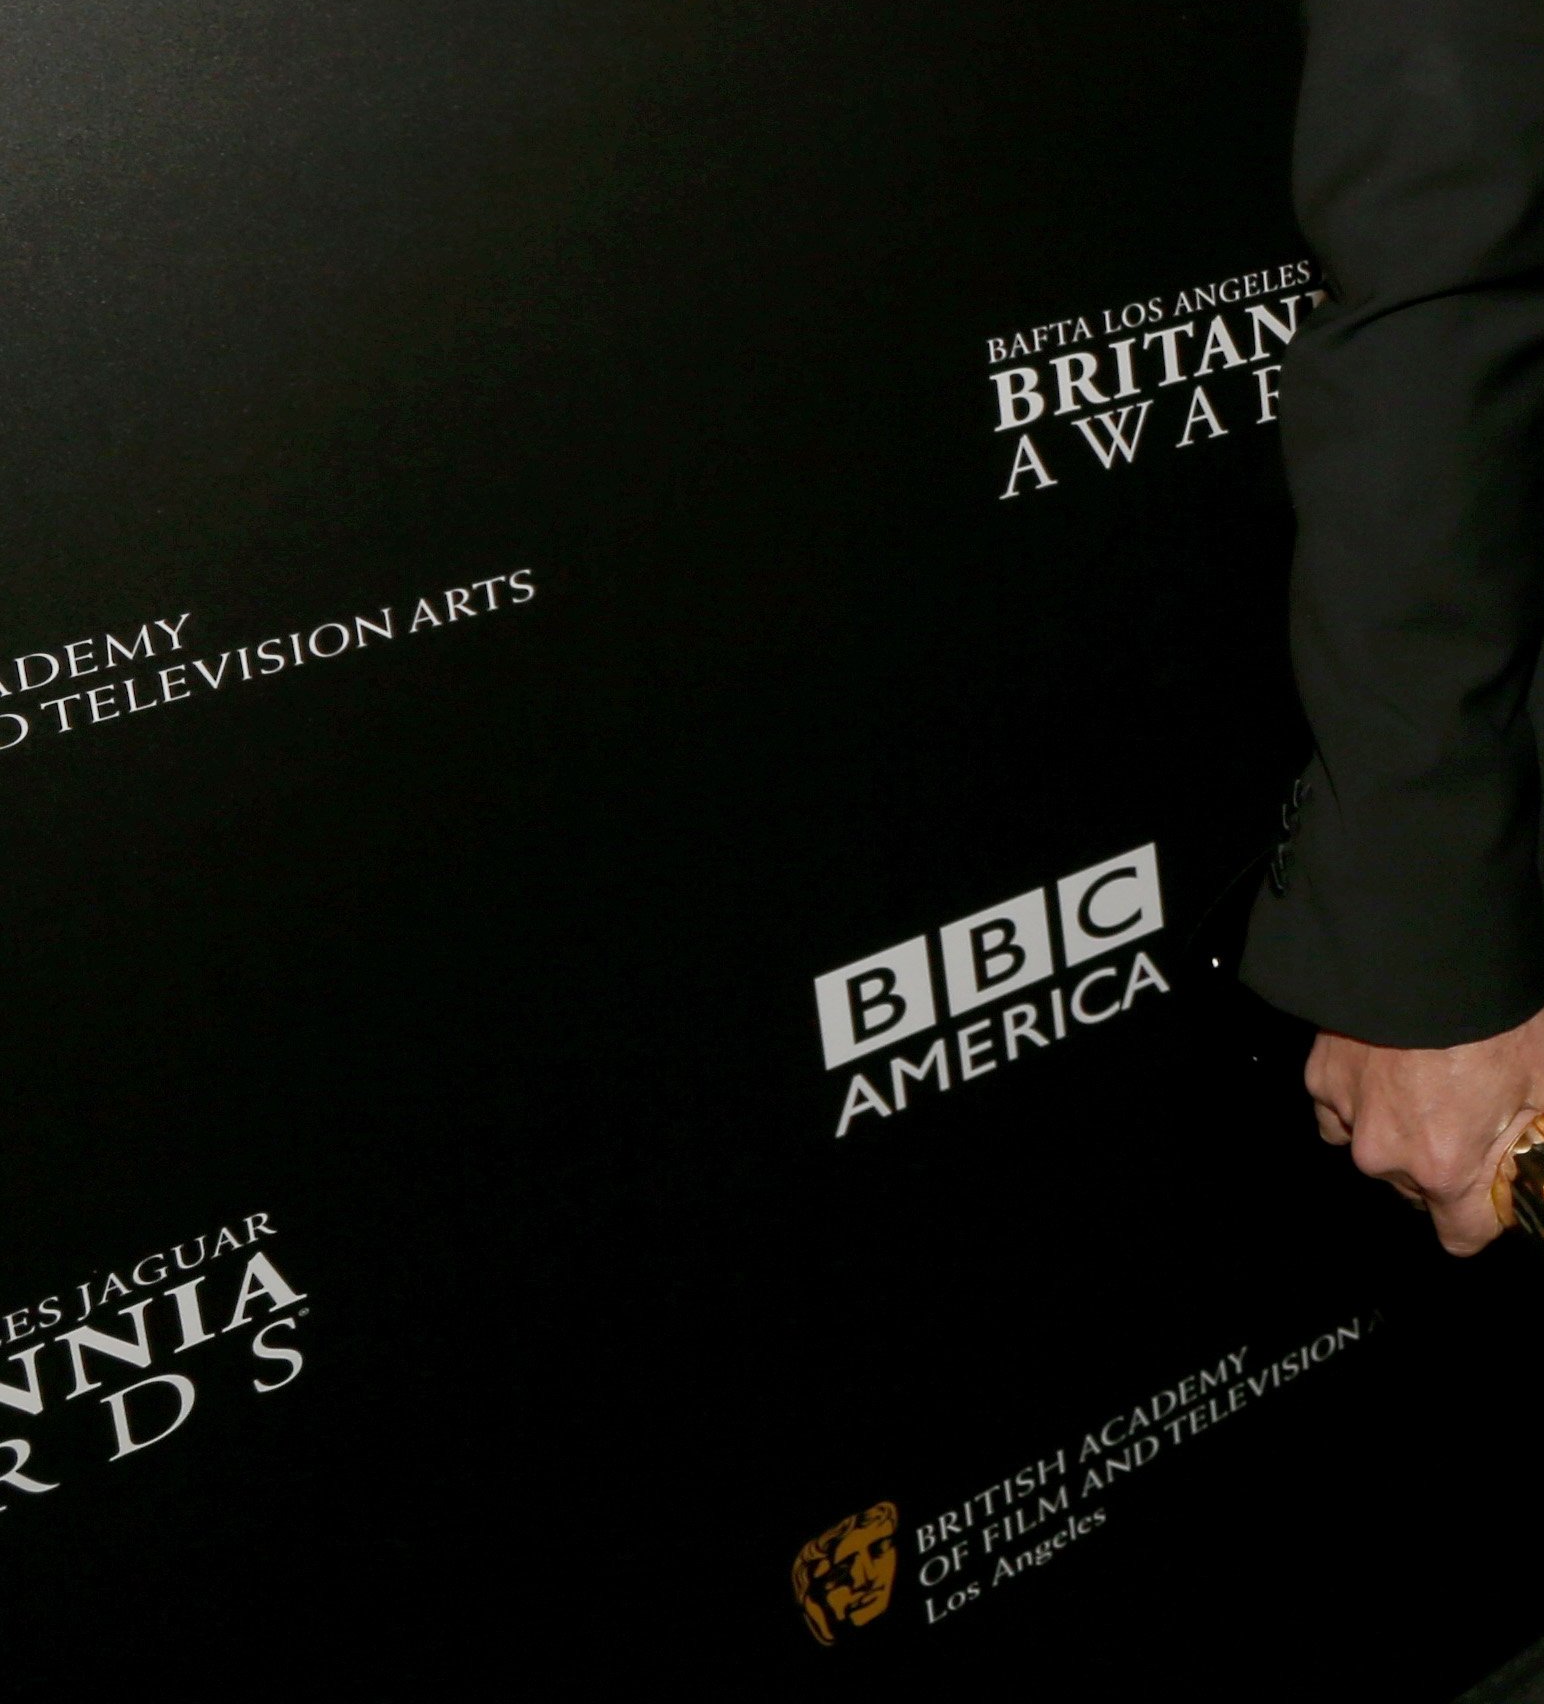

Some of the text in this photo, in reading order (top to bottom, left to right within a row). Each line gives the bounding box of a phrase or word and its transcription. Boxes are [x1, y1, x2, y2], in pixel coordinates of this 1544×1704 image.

[987, 263, 1310, 364] BAFTA LOS ANGELES
[988, 289, 1329, 432] BRITAN
[40, 607, 393, 733] TELEVISION
[409, 569, 535, 633] ARTS
[846, 866, 1142, 1046] BBC
[835, 951, 1170, 1138] AMERICA
[76, 1212, 279, 1323] JAGUAR
[916, 1346, 1247, 1554] BRITISH ACADEMY
[919, 1545, 968, 1587] OF
[982, 1485, 1069, 1553] FILM
[1082, 1436, 1160, 1498] AND
[1163, 1318, 1360, 1445] TELEVISION
[925, 1511, 1107, 1624] Los Angeles
